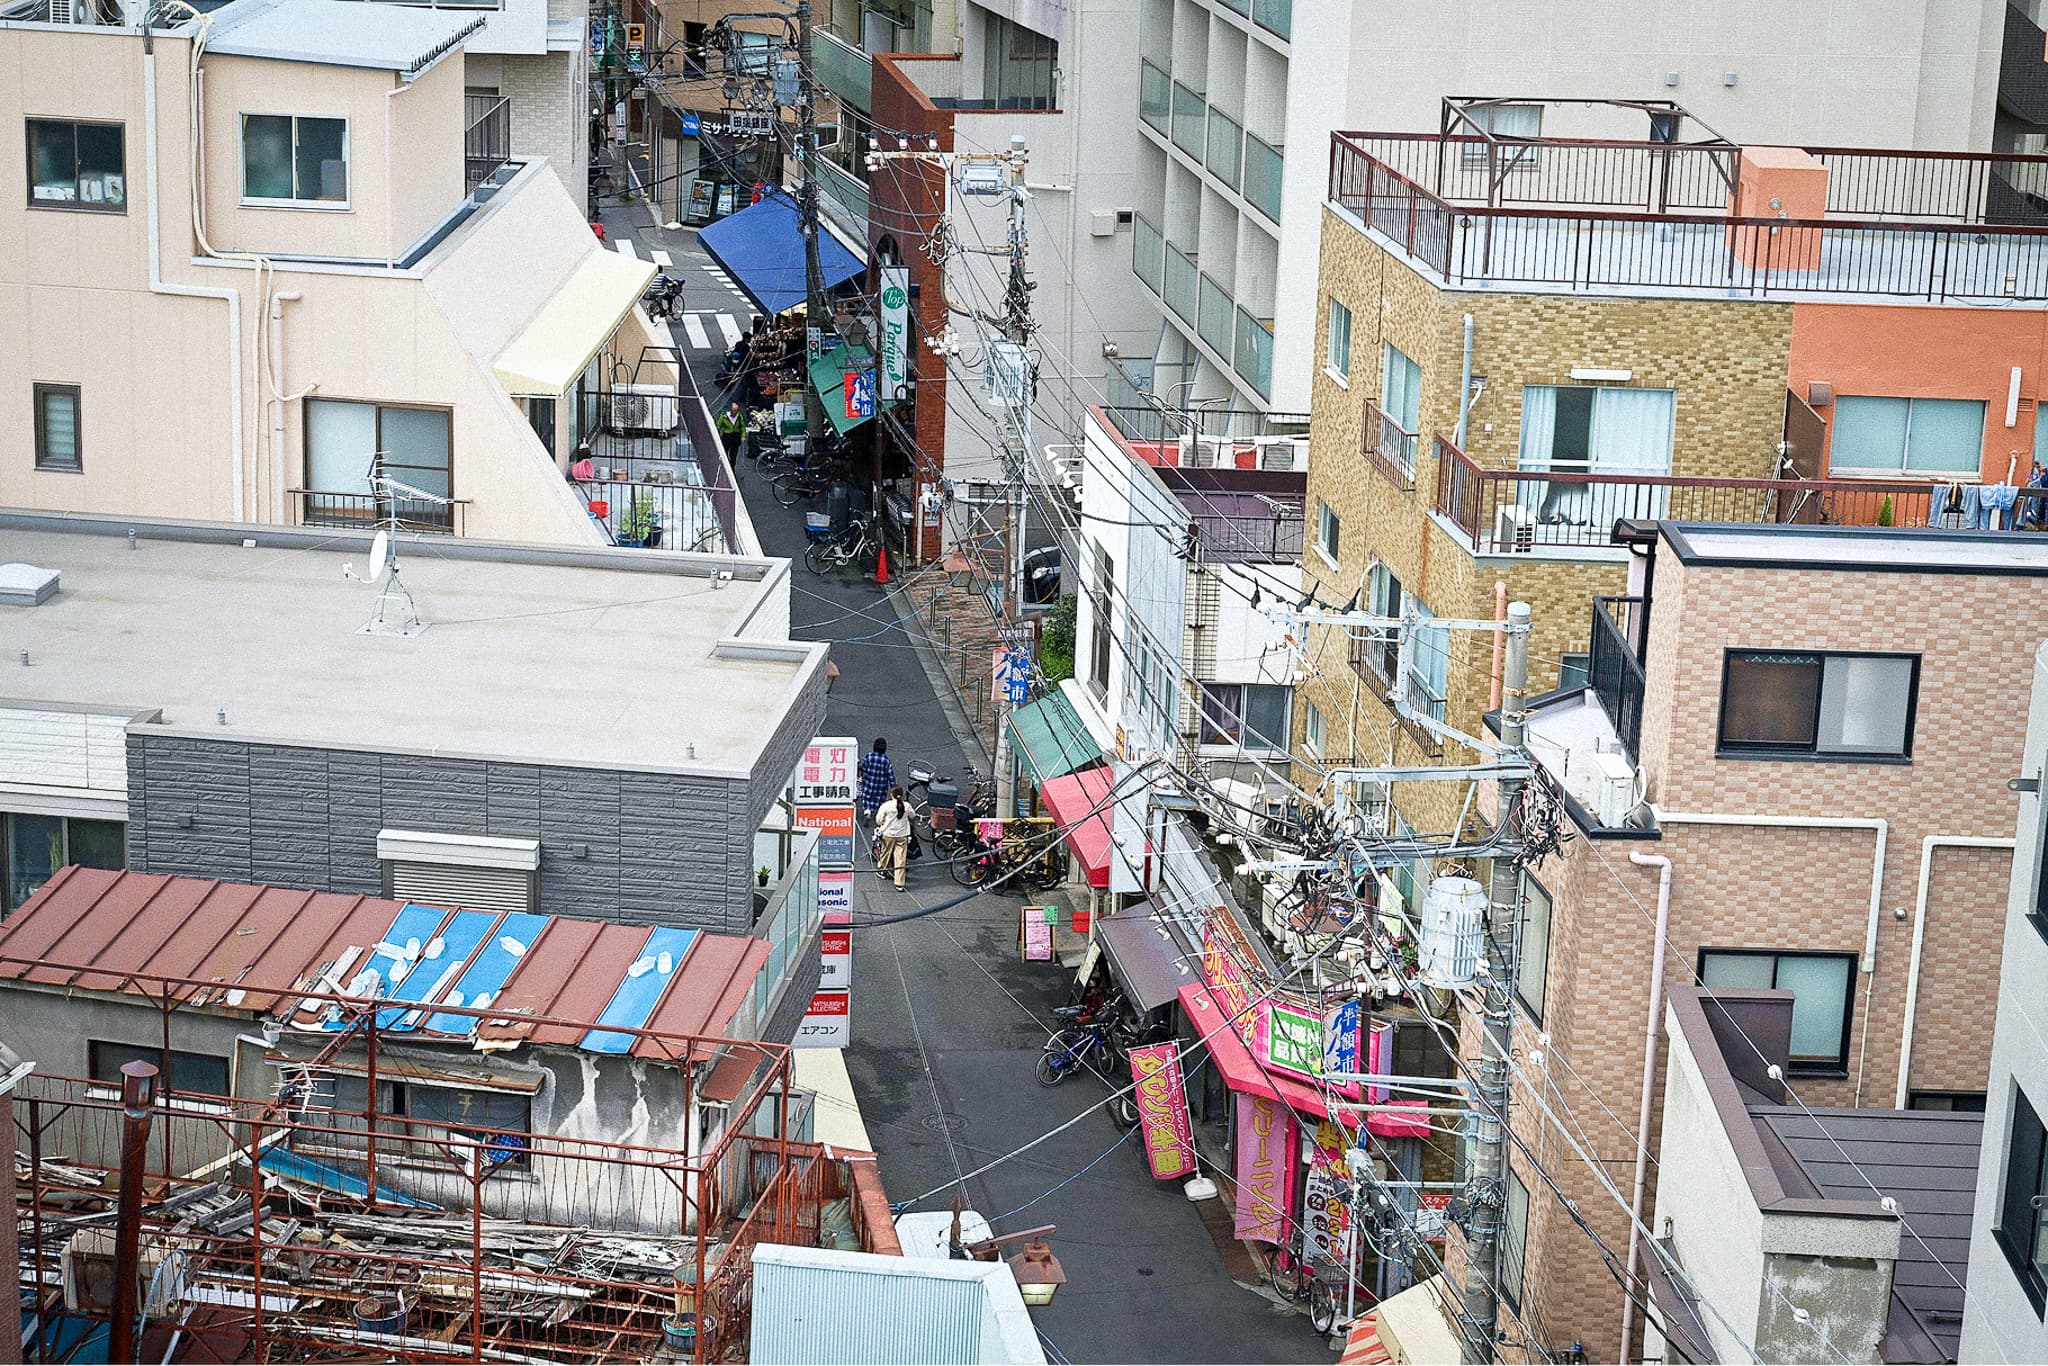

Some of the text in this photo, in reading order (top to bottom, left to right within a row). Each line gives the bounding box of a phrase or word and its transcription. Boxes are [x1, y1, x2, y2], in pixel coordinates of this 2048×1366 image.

[630, 27, 642, 41] P
[882, 319, 903, 373] Parque
[804, 747, 847, 764] 電灯
[803, 766, 847, 782] 電力
[799, 785, 851, 799] 工事請負
[798, 816, 852, 827] National
[819, 887, 844, 897] ional
[818, 898, 848, 907] sonic
[801, 1026, 839, 1035] エアコン
